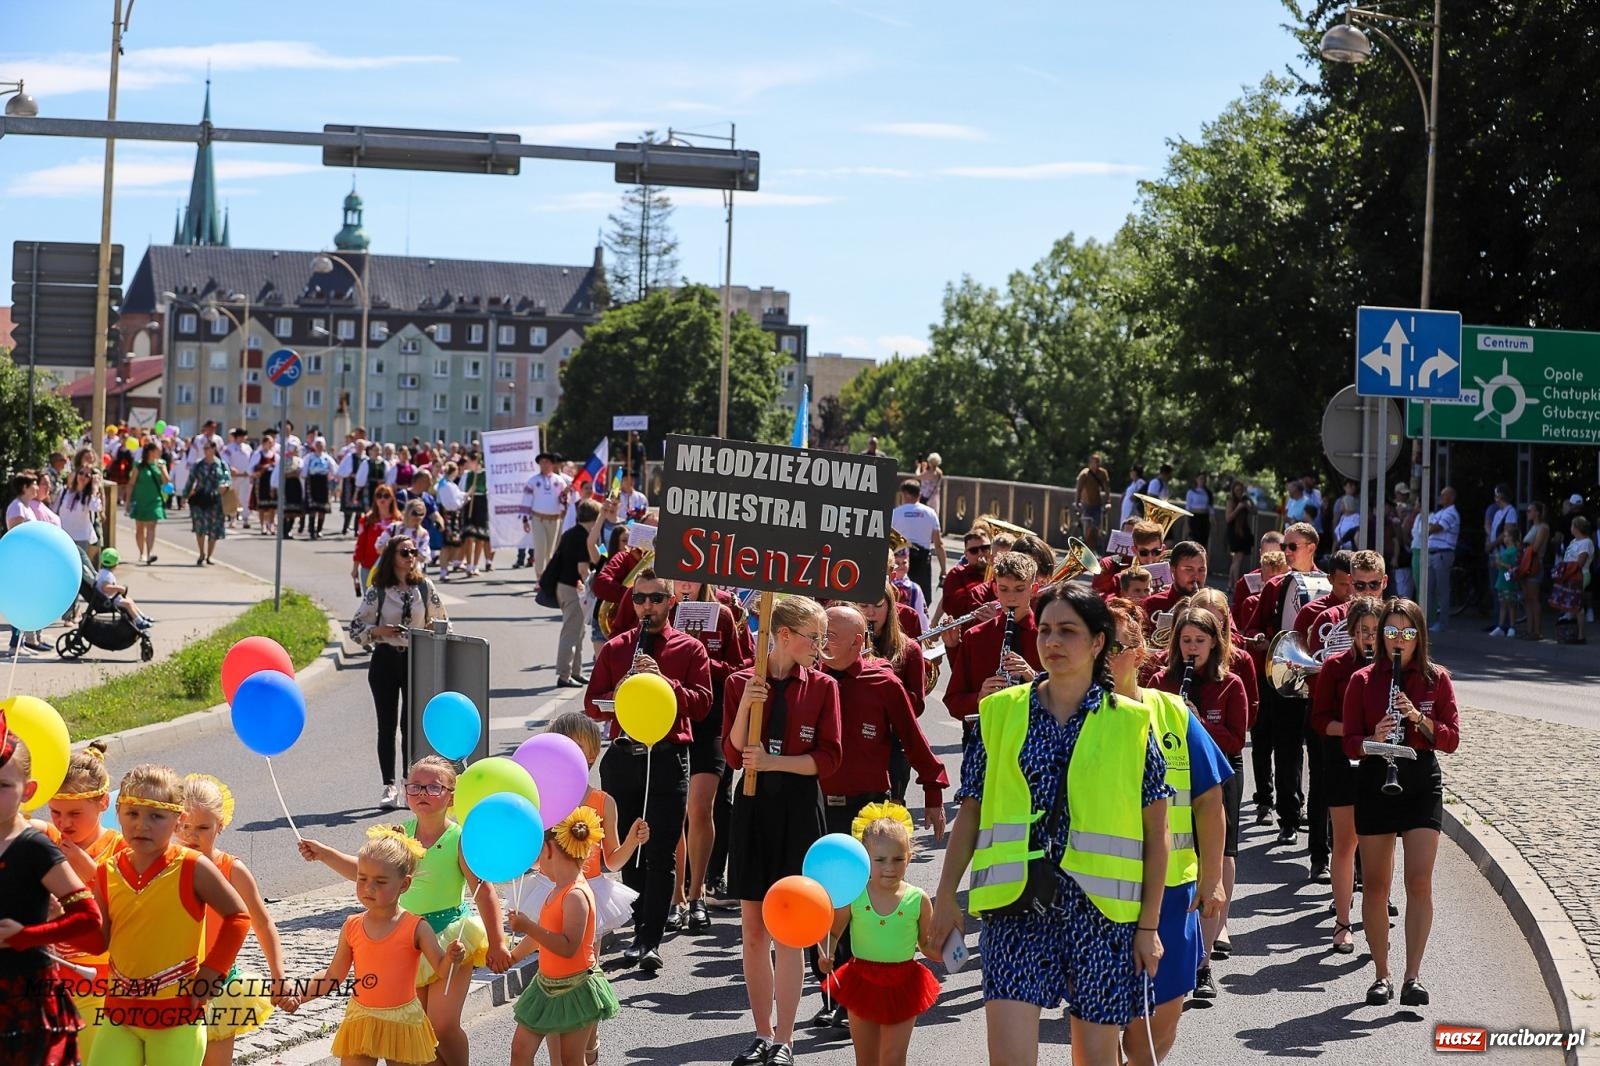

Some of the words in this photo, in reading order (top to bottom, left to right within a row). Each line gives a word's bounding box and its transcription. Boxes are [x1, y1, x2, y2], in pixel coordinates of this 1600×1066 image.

[1483, 336, 1529, 350] Centrum
[1544, 367, 1584, 383] Opole
[676, 444, 879, 494] MŁODZIEŻOWA
[666, 486, 807, 529] ORKIESTRA
[820, 504, 885, 539] DĘTA
[677, 527, 861, 592] Silenzio
